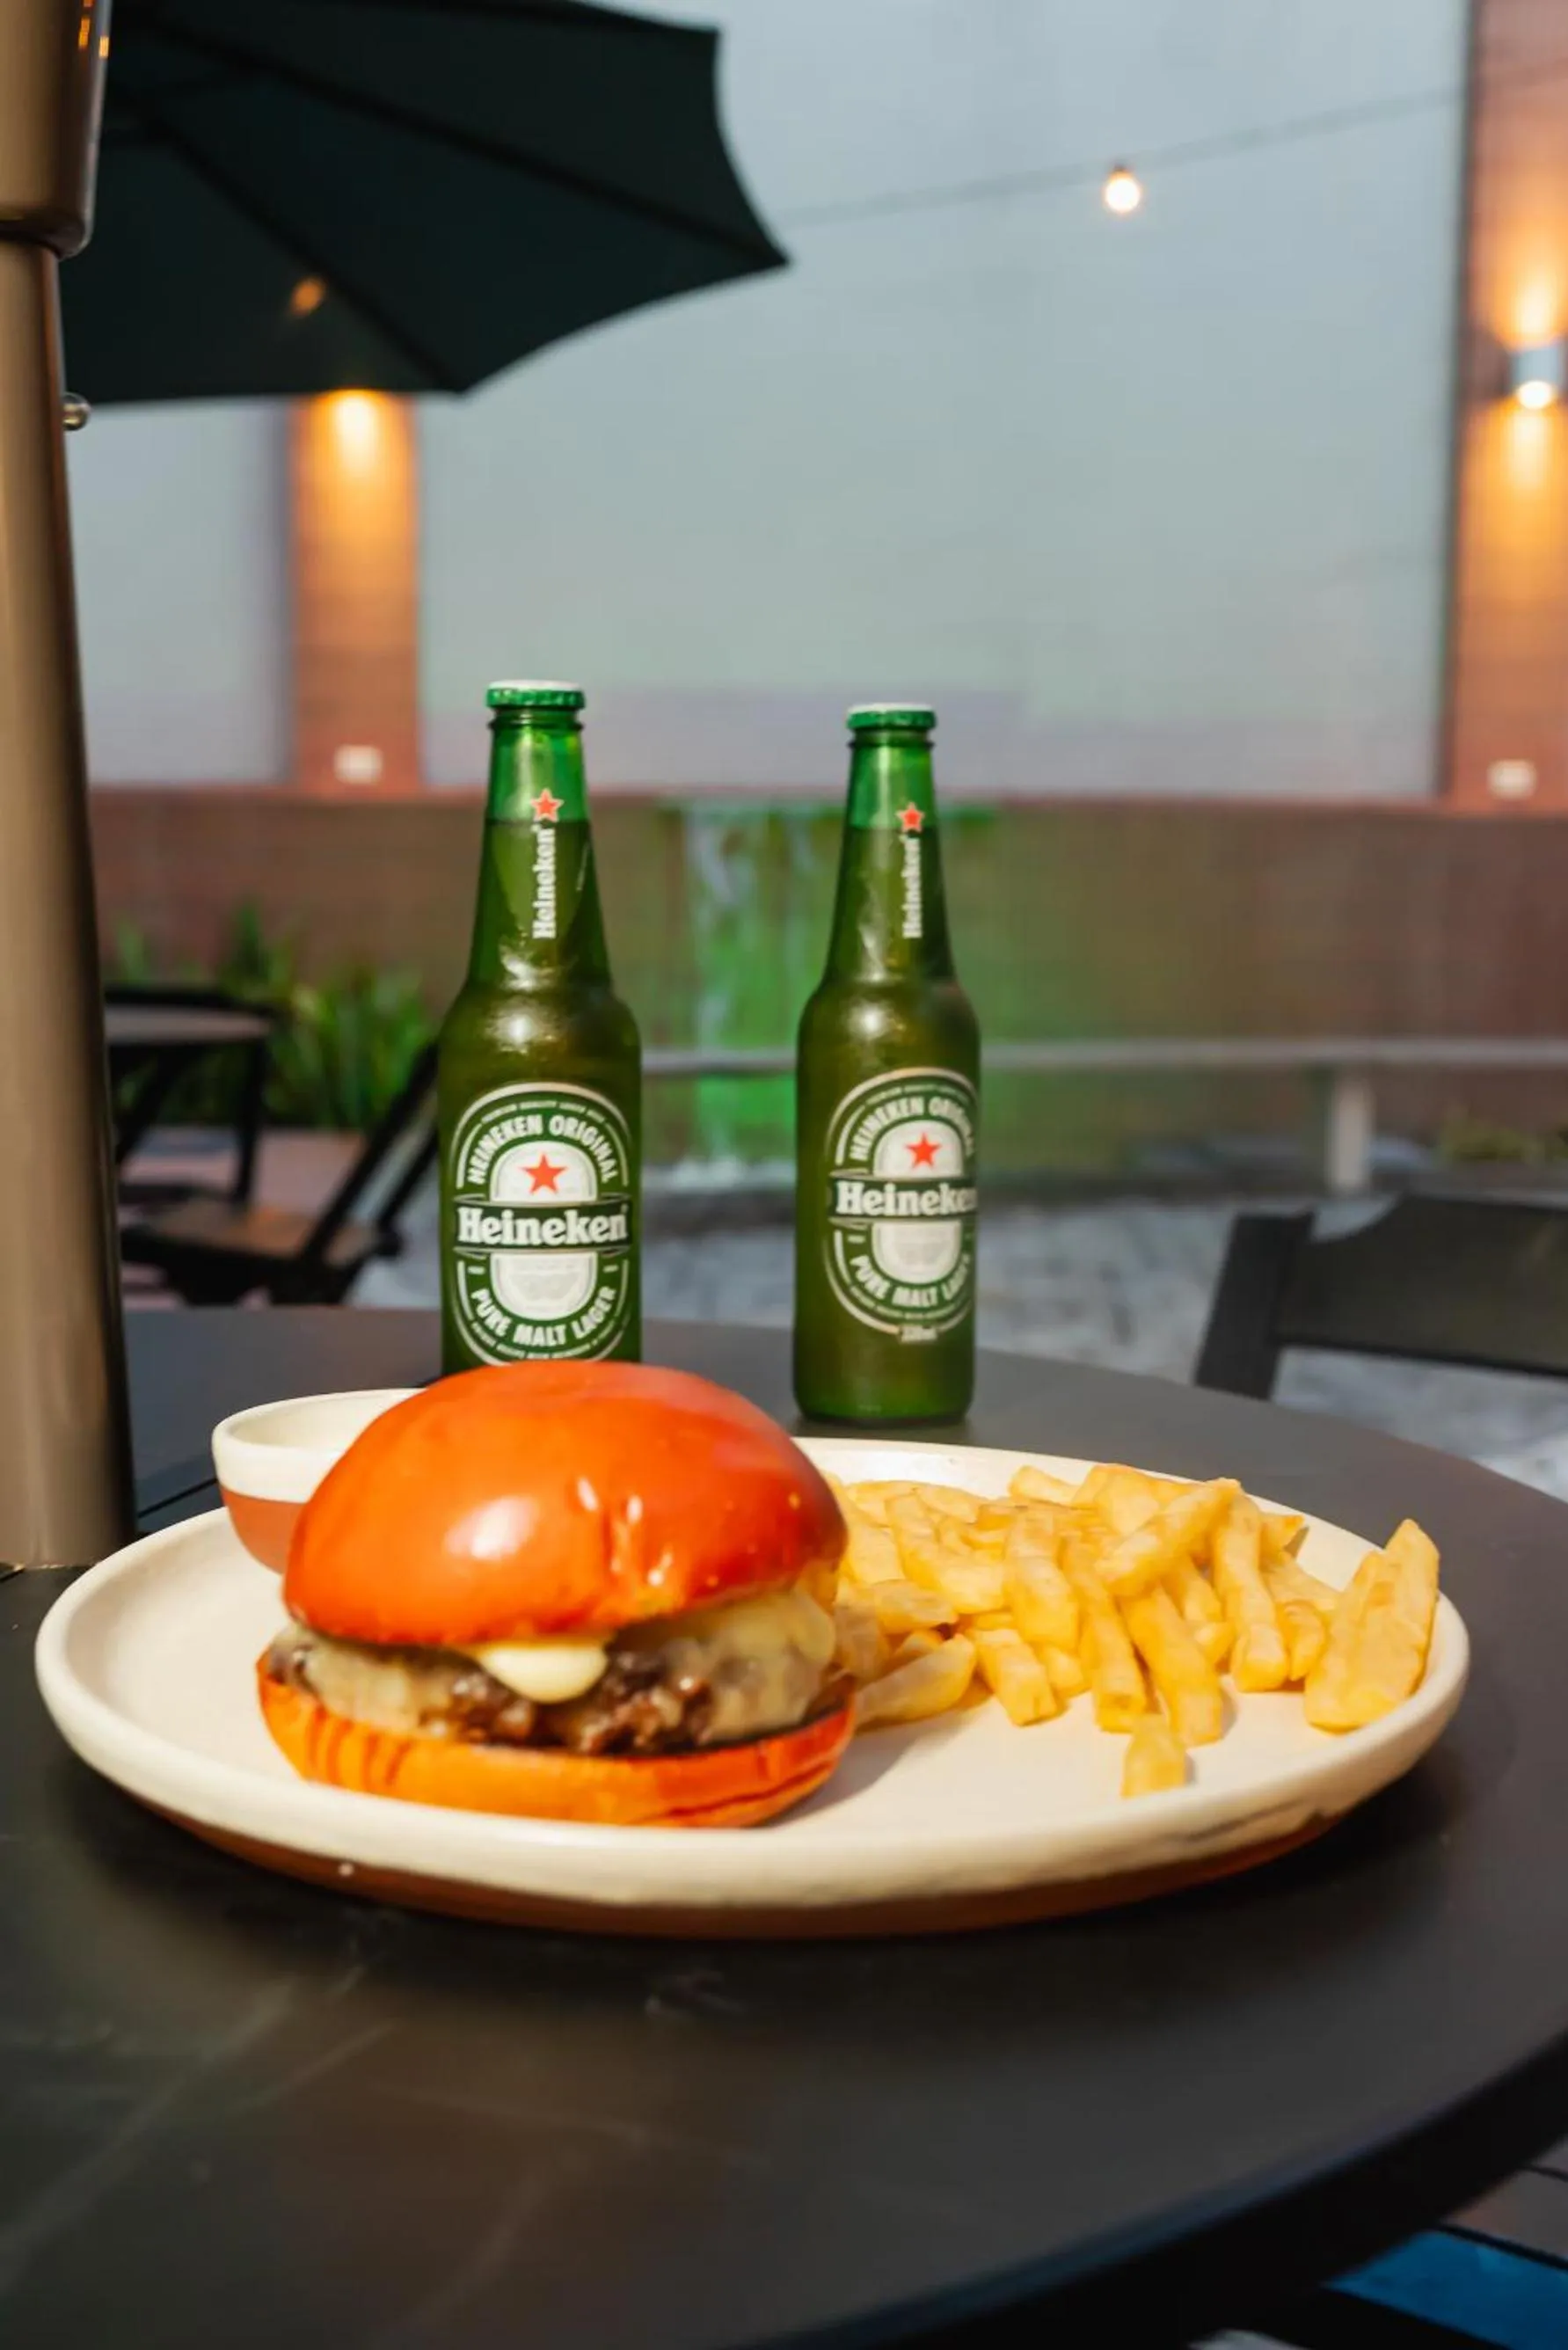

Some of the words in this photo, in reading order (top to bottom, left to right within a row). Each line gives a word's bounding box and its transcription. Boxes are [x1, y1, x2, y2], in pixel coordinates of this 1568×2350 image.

[531, 827, 556, 938] Heineken
[549, 1114, 618, 1184] ORIGINAL
[457, 1206, 629, 1246] Heineken
[471, 1288, 513, 1337] PURE
[513, 1323, 567, 1347] MALT
[572, 1285, 616, 1339] LAGER
